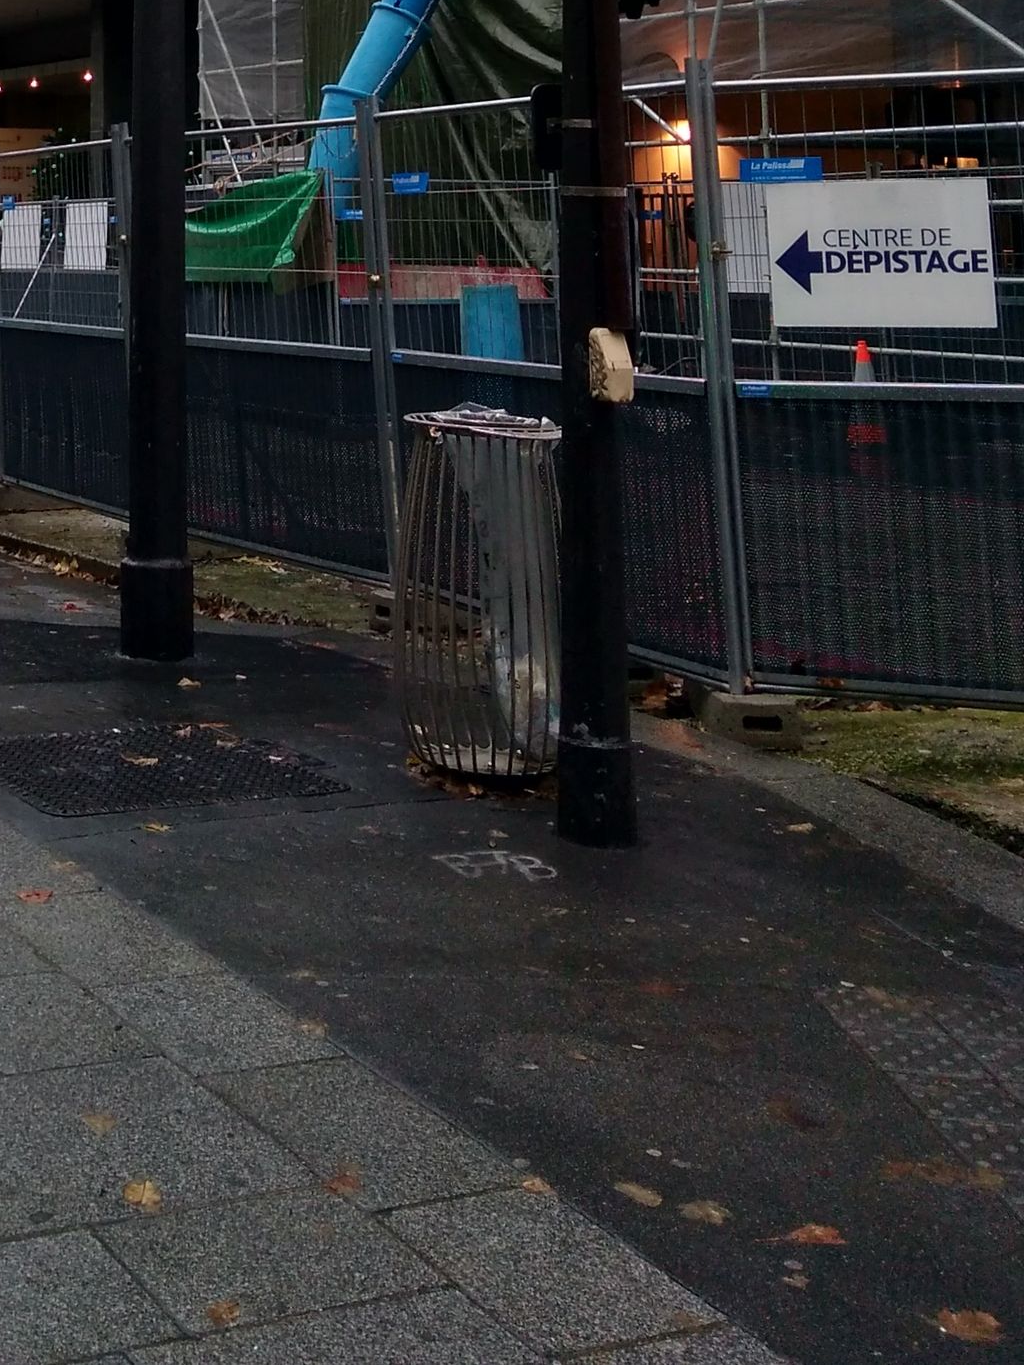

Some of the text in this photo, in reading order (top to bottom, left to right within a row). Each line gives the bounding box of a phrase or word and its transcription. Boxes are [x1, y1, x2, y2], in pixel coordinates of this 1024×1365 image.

[751, 161, 761, 170] La
[822, 228, 952, 247] CENTRE DE
[825, 244, 989, 274] DÉPISTAGE
